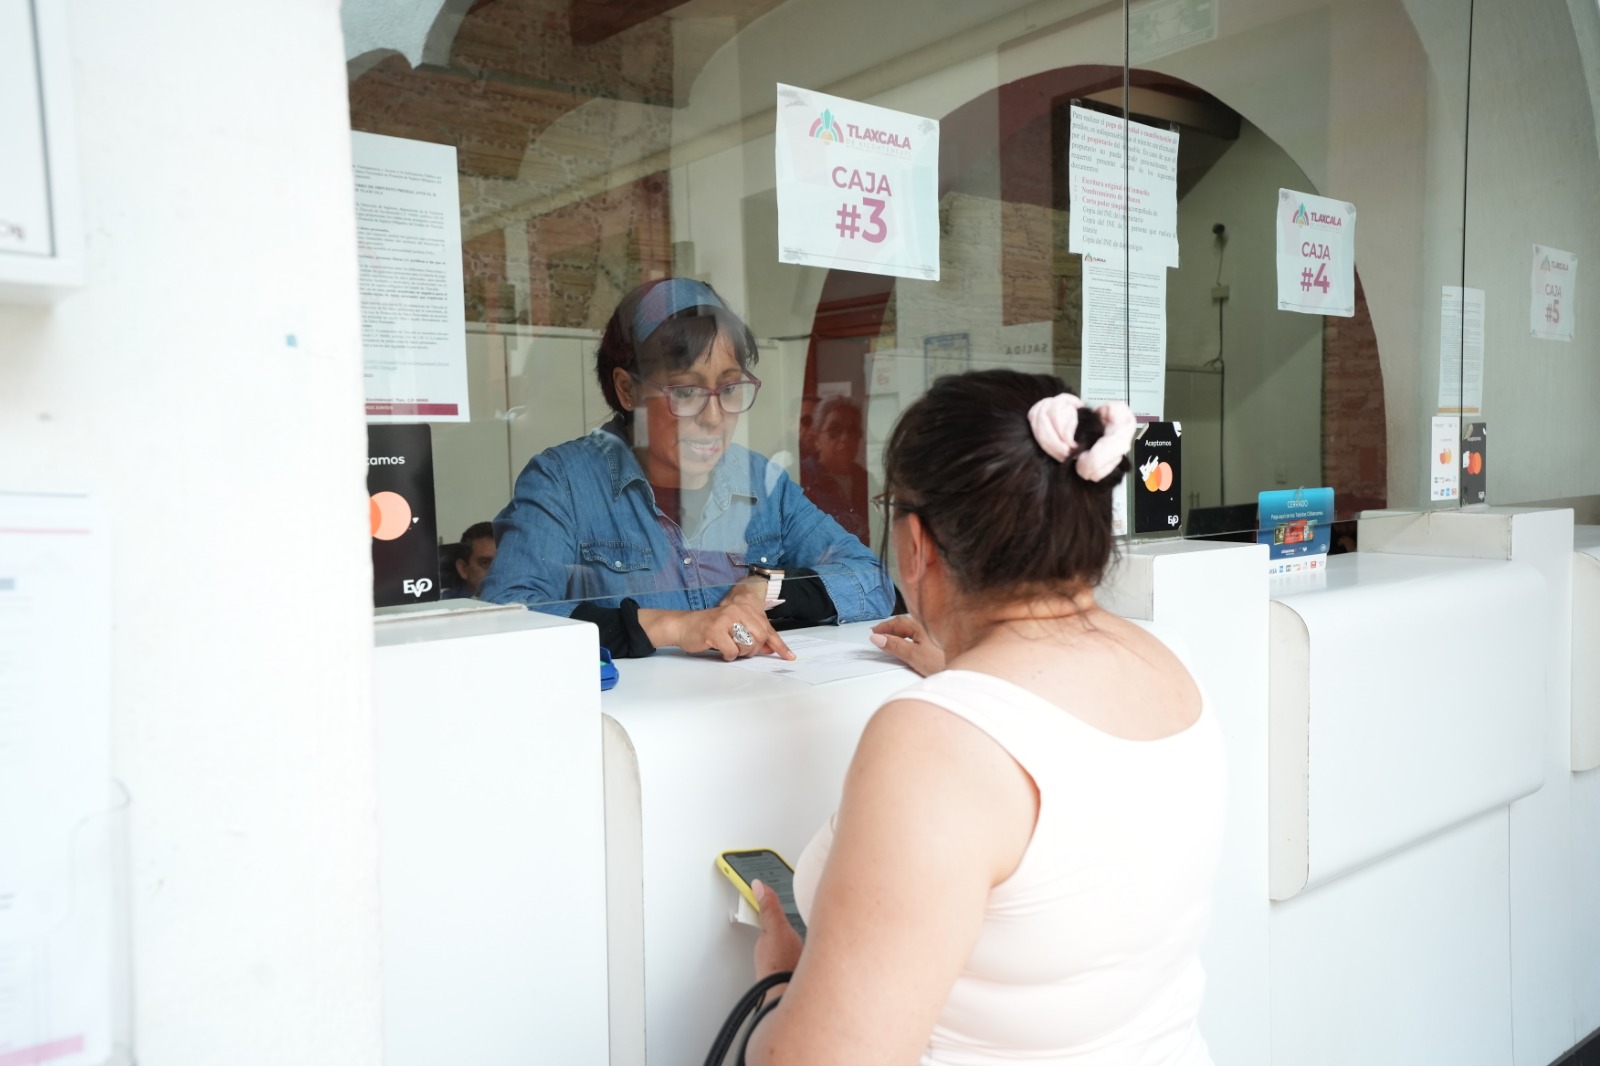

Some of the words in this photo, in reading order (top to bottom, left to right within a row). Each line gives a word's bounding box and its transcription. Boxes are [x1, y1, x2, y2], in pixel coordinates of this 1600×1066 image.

[846, 123, 911, 150] TLAXCALA
[832, 166, 892, 196] CAJA
[835, 196, 888, 243] #3
[1310, 212, 1342, 226] TLAXCALA
[1301, 242, 1331, 260] CAJA
[1300, 263, 1330, 294] #4
[1545, 283, 1562, 297] CAJA
[1545, 299, 1560, 323] #5
[1145, 439, 1172, 448] Aceptamos
[1287, 499, 1309, 508] CERRADO
[403, 577, 433, 598] EVO
